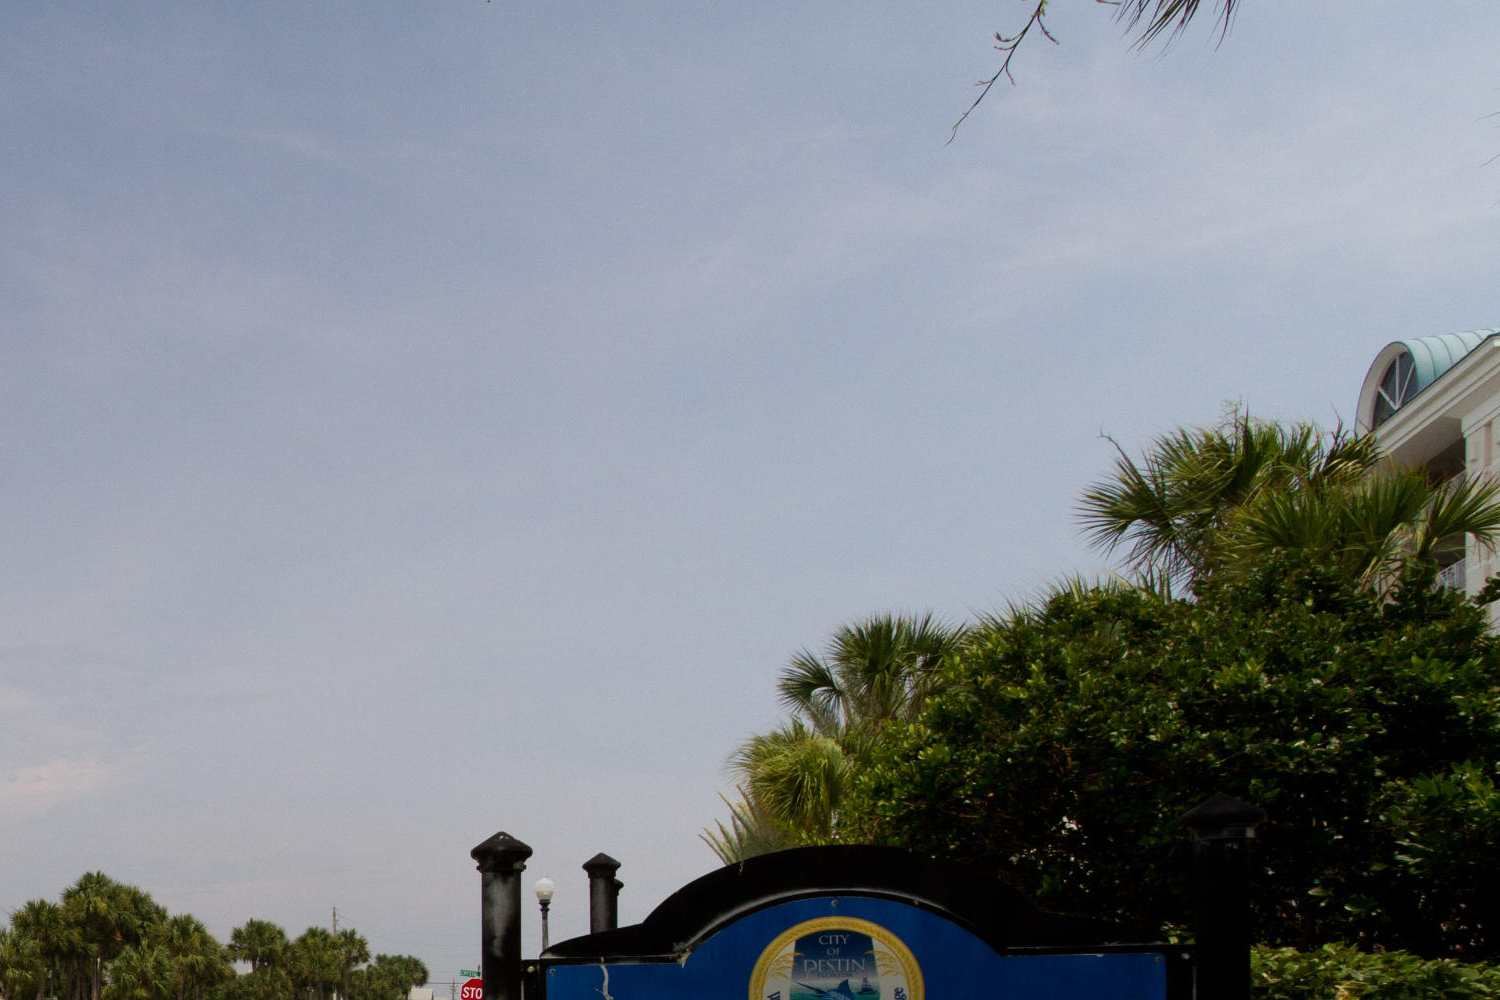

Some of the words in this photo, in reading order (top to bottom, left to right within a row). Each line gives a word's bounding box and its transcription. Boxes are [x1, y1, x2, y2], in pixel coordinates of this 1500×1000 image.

[818, 934, 850, 945] CITY
[826, 947, 841, 955] OF
[803, 958, 865, 972] DESTIN
[462, 987, 482, 999] STO
